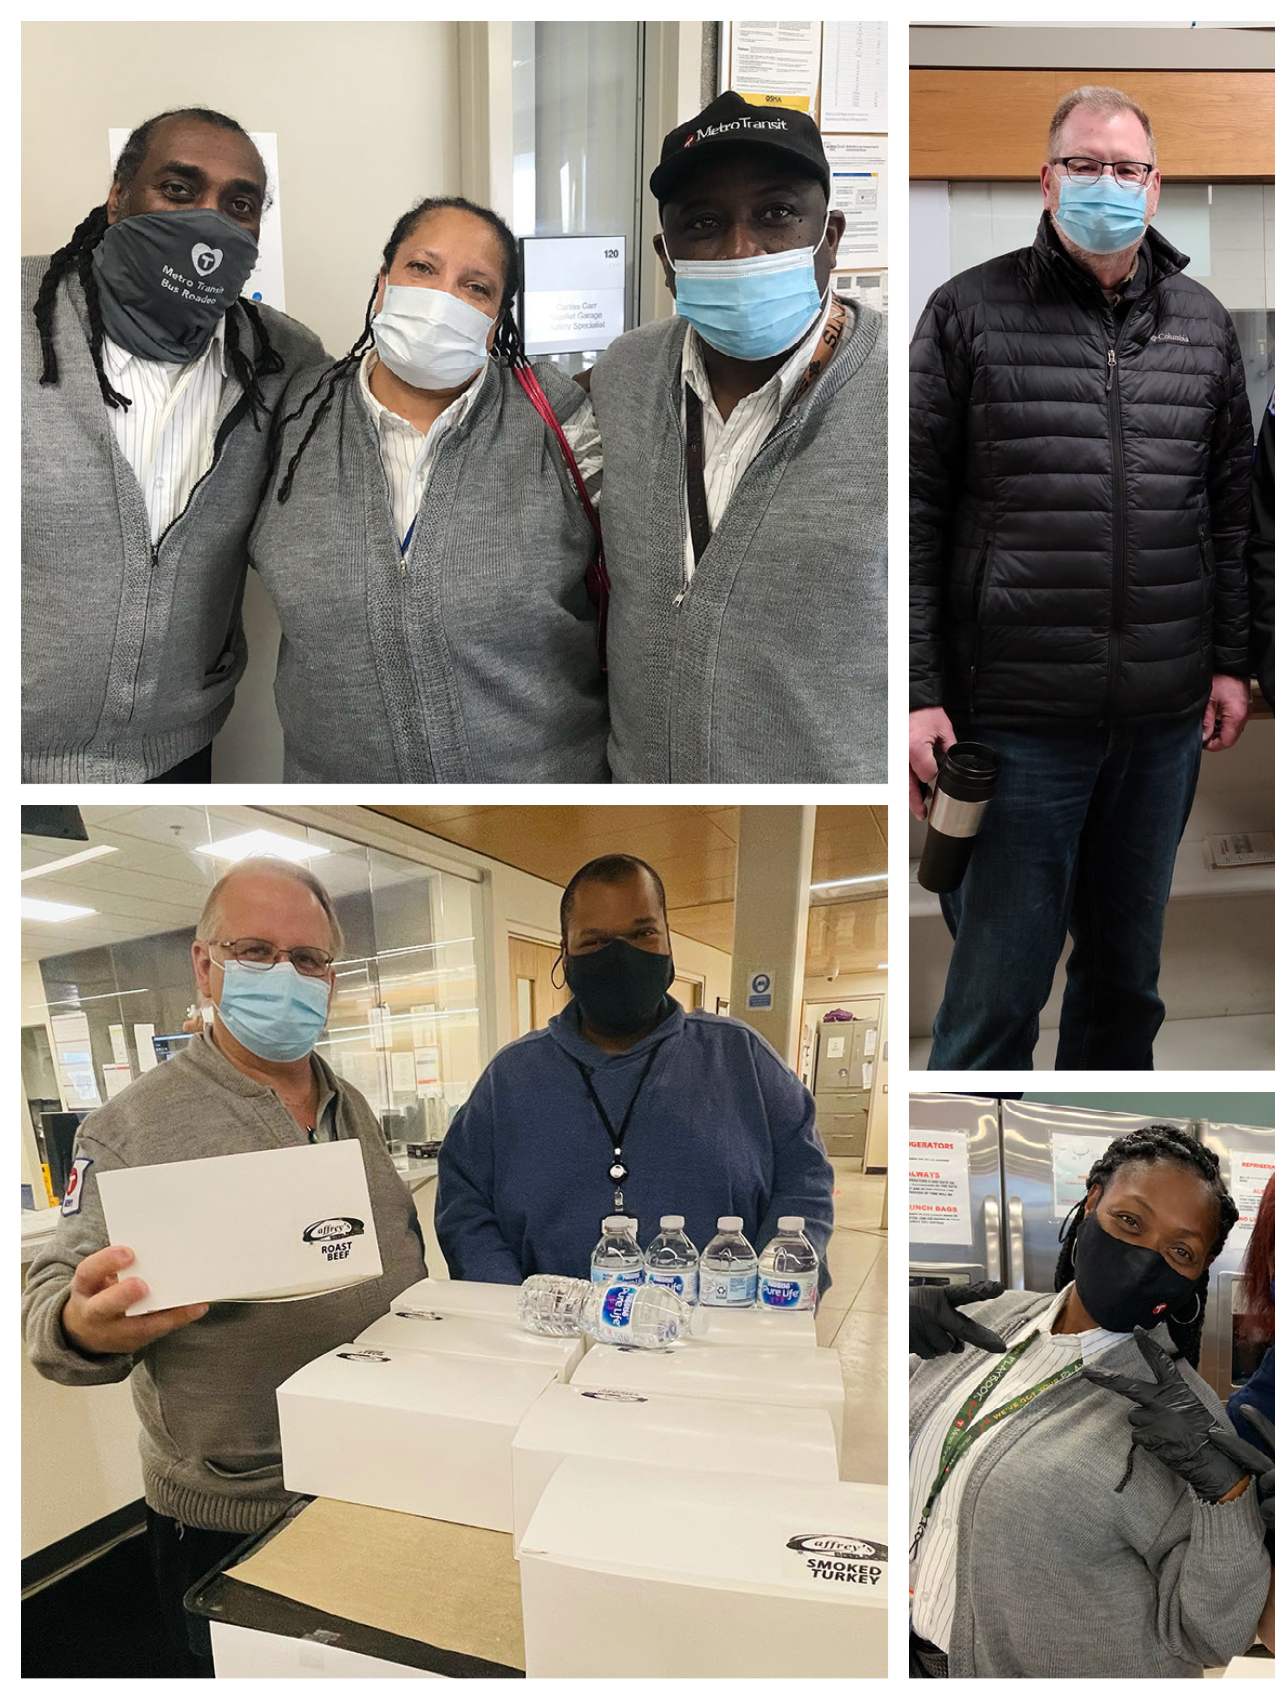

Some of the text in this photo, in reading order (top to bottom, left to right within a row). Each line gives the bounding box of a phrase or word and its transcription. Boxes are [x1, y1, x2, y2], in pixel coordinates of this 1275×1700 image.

[604, 249, 619, 258] 120
[162, 264, 224, 294] Metro Transit
[161, 278, 217, 305] Bus Roadeo
[577, 312, 603, 320] Garage
[573, 321, 605, 331] Specialist
[1158, 333, 1189, 342] Columbia
[321, 1241, 352, 1254] ROAST
[327, 1250, 350, 1261] BEEF
[762, 1285, 800, 1300] Pure Life
[610, 1287, 628, 1326] Pure Life
[973, 1355, 1016, 1402] PLAYBOOK
[993, 1402, 1019, 1420] WE'VE
[1020, 1391, 1037, 1403] GOT
[806, 1558, 882, 1576] SMOKED
[811, 1568, 880, 1586] TURKEY
